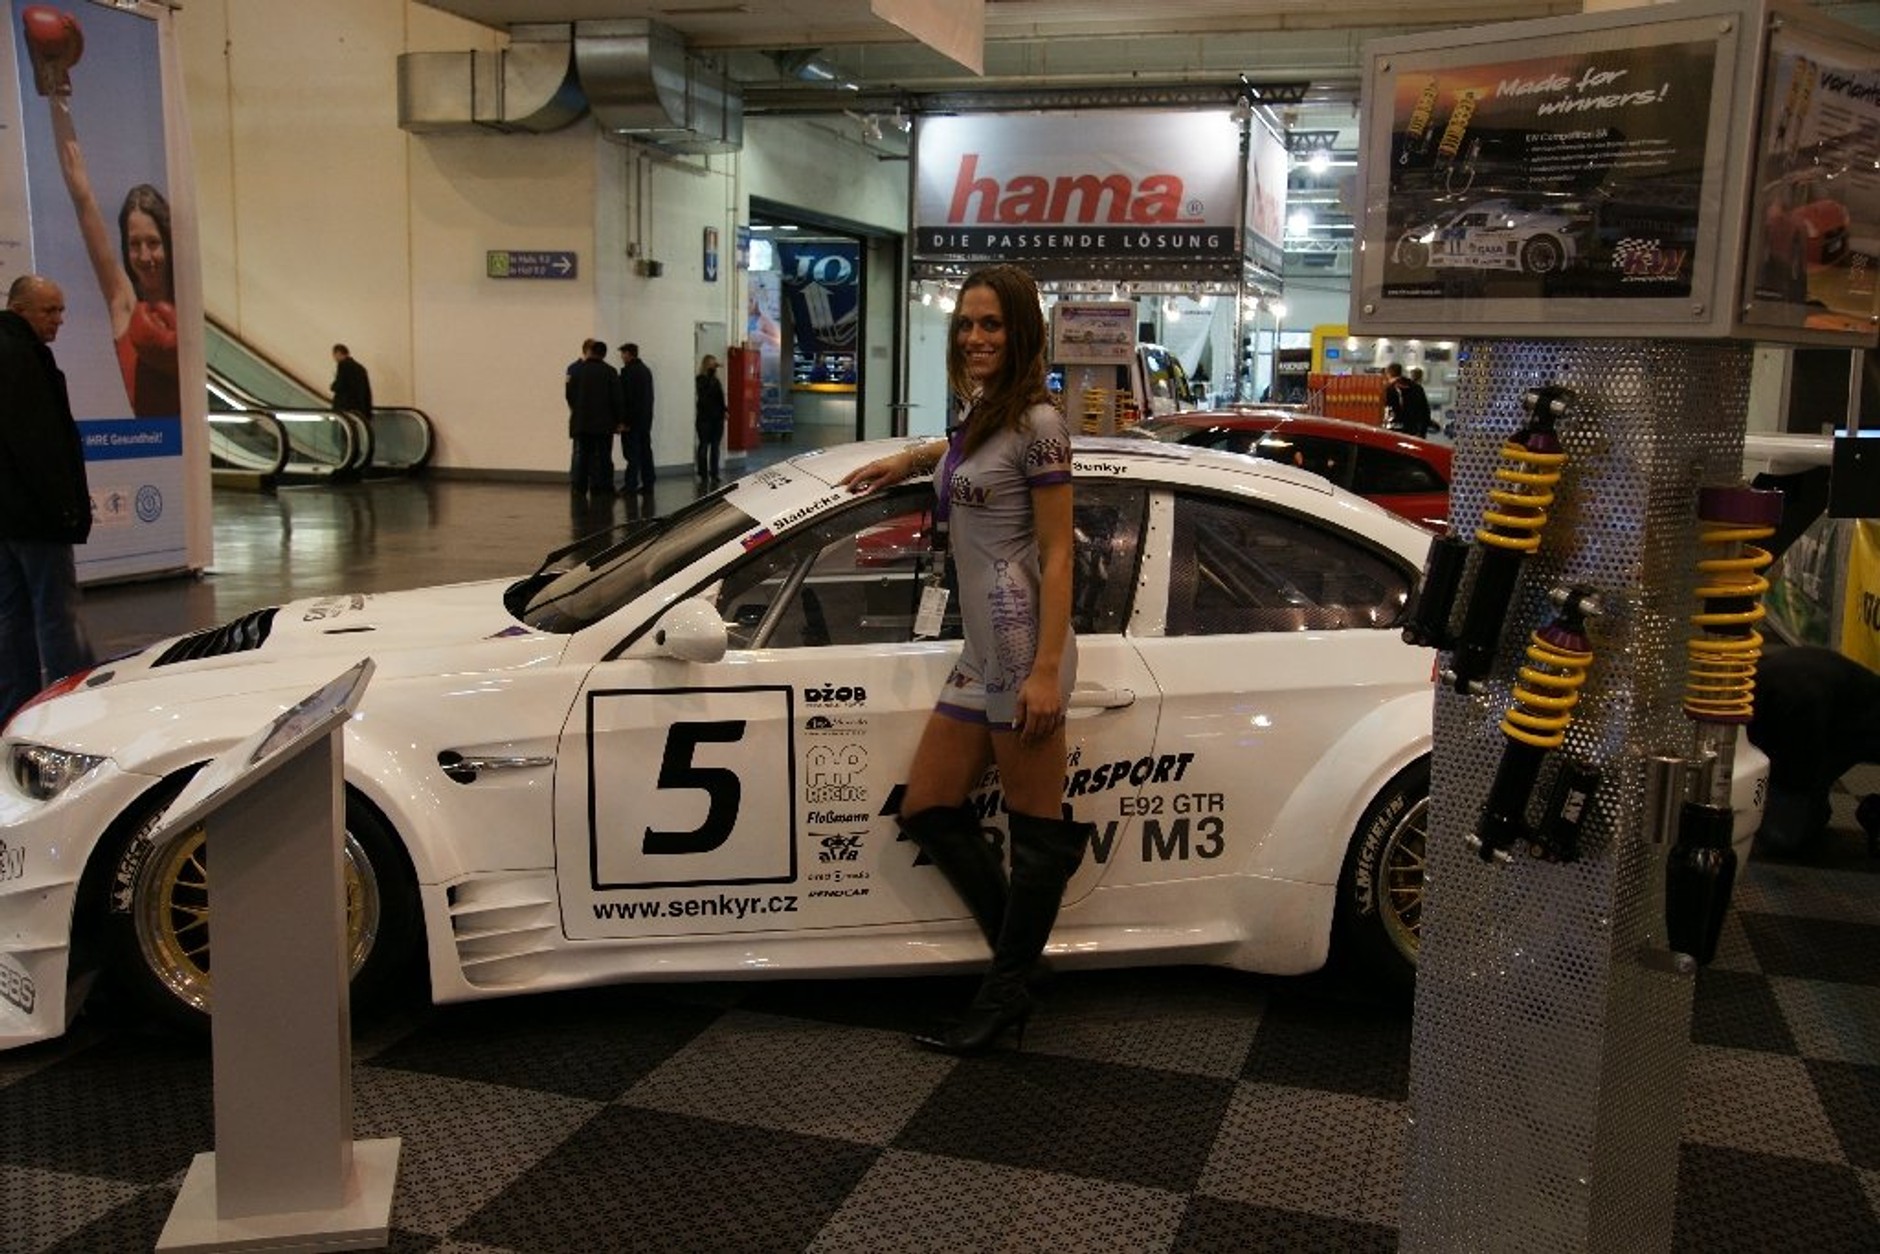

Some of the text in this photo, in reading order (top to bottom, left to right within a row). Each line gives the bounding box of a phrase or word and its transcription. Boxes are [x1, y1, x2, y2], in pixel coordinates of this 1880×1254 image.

[1496, 66, 1628, 98] Made for
[1537, 82, 1669, 116] winners!
[947, 153, 1184, 224] hama
[934, 231, 1219, 248] DIE PASSENDE LÖSUNG
[804, 683, 867, 702] DŽOB
[642, 720, 746, 855] 5
[1119, 793, 1225, 817] E92 GTR
[1141, 817, 1225, 863] M3
[593, 894, 798, 919] www.senkyr.cz
